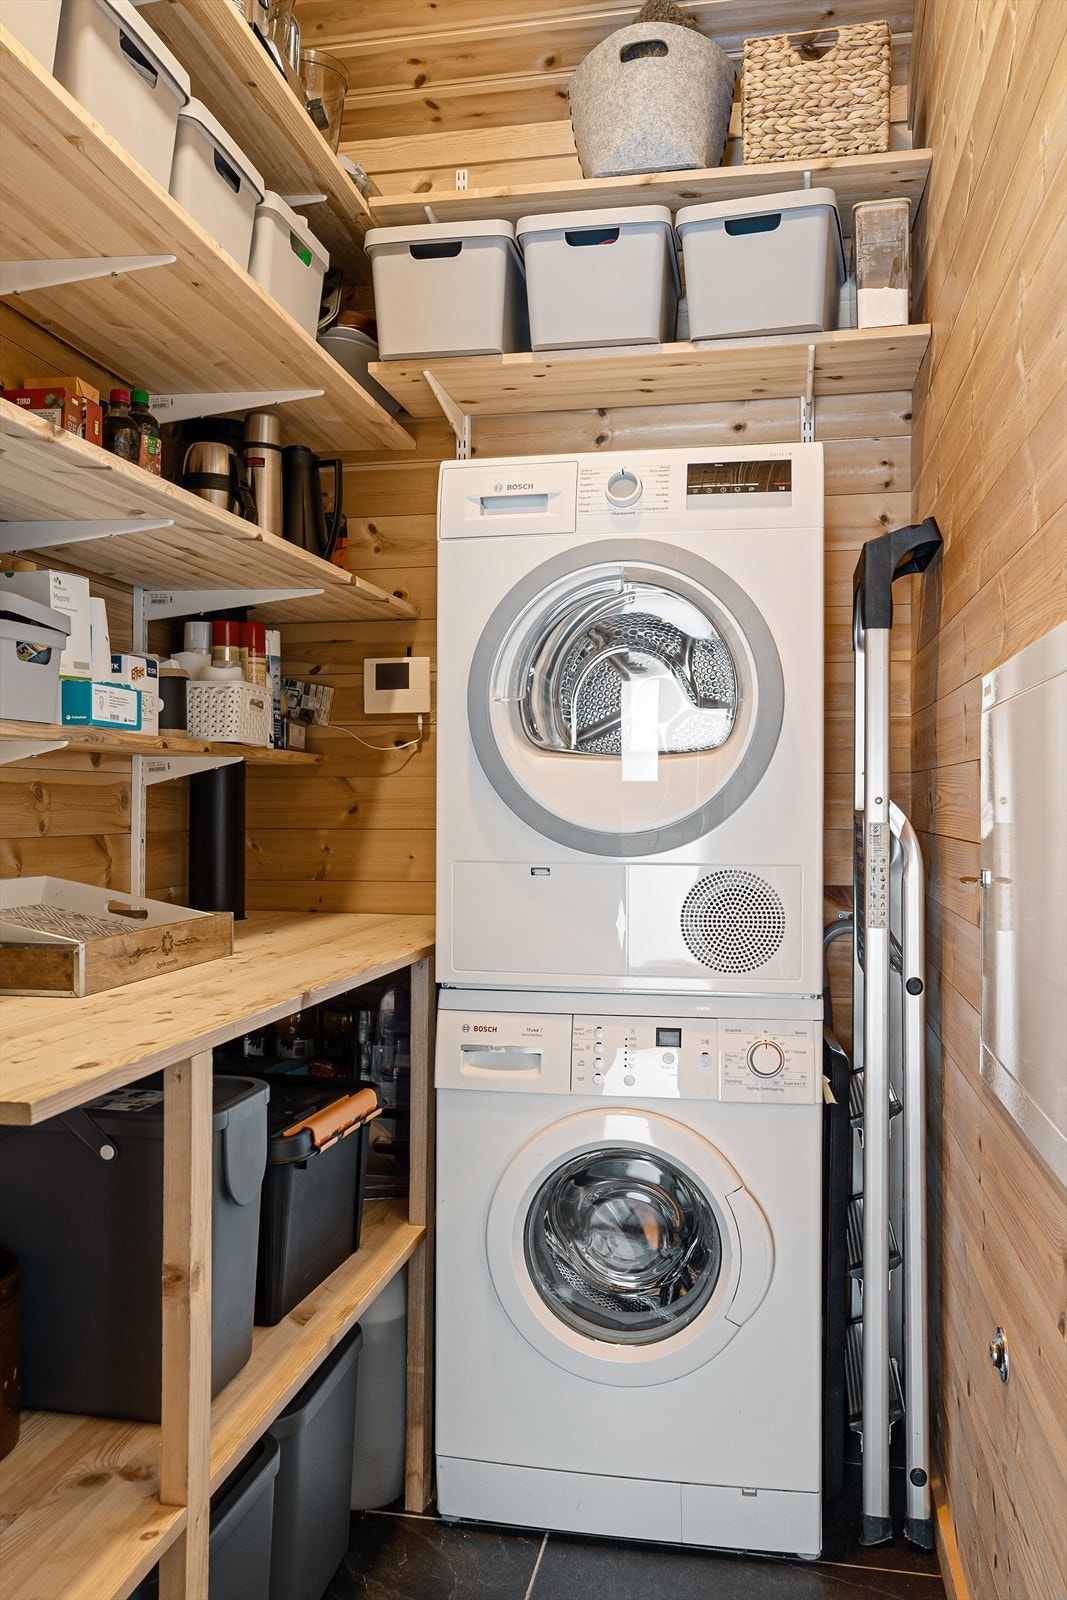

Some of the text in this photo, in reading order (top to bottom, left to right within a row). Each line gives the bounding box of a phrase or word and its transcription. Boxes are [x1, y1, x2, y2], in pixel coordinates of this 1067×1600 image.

[17, 397, 31, 405] TORO
[506, 483, 534, 491] BOSCH
[473, 1025, 498, 1033] BOSCH
